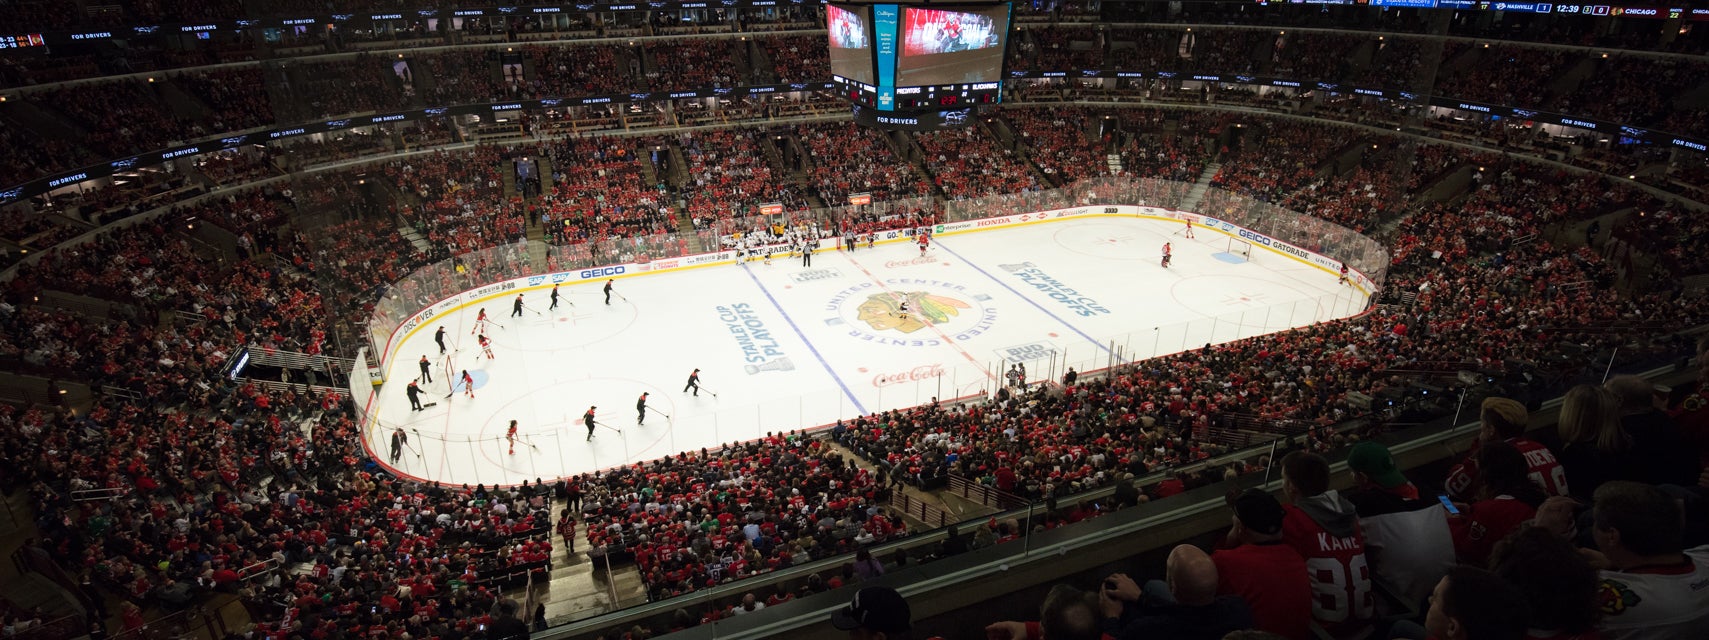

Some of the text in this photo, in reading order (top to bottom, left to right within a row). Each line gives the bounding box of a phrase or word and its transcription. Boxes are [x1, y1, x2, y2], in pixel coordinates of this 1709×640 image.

[890, 117, 918, 125] DRIVERS
[1573, 120, 1596, 128] DRIVERS
[174, 148, 198, 157] DRIVERS
[1685, 141, 1706, 150] DRIVERS
[49, 173, 87, 187] FOR DRIVERS
[978, 218, 1010, 226] HONDA
[1239, 229, 1270, 246] GEICO
[1273, 241, 1309, 259] GATORADE
[580, 266, 625, 279] GEICO
[1316, 258, 1340, 270] UNITED
[825, 279, 966, 310] UNITED CENTER
[1013, 273, 1097, 316] PLAYOFFS
[1024, 269, 1111, 314] STANLEY CUP
[716, 306, 766, 362] STANLEY CUP
[731, 303, 784, 356] PLAYOFFS
[849, 308, 997, 346] UNITED CENTER
[1006, 344, 1044, 355] BUD
[872, 364, 945, 388] Coca-Cola
[1318, 532, 1360, 551] KANE
[1307, 553, 1374, 622] 88
